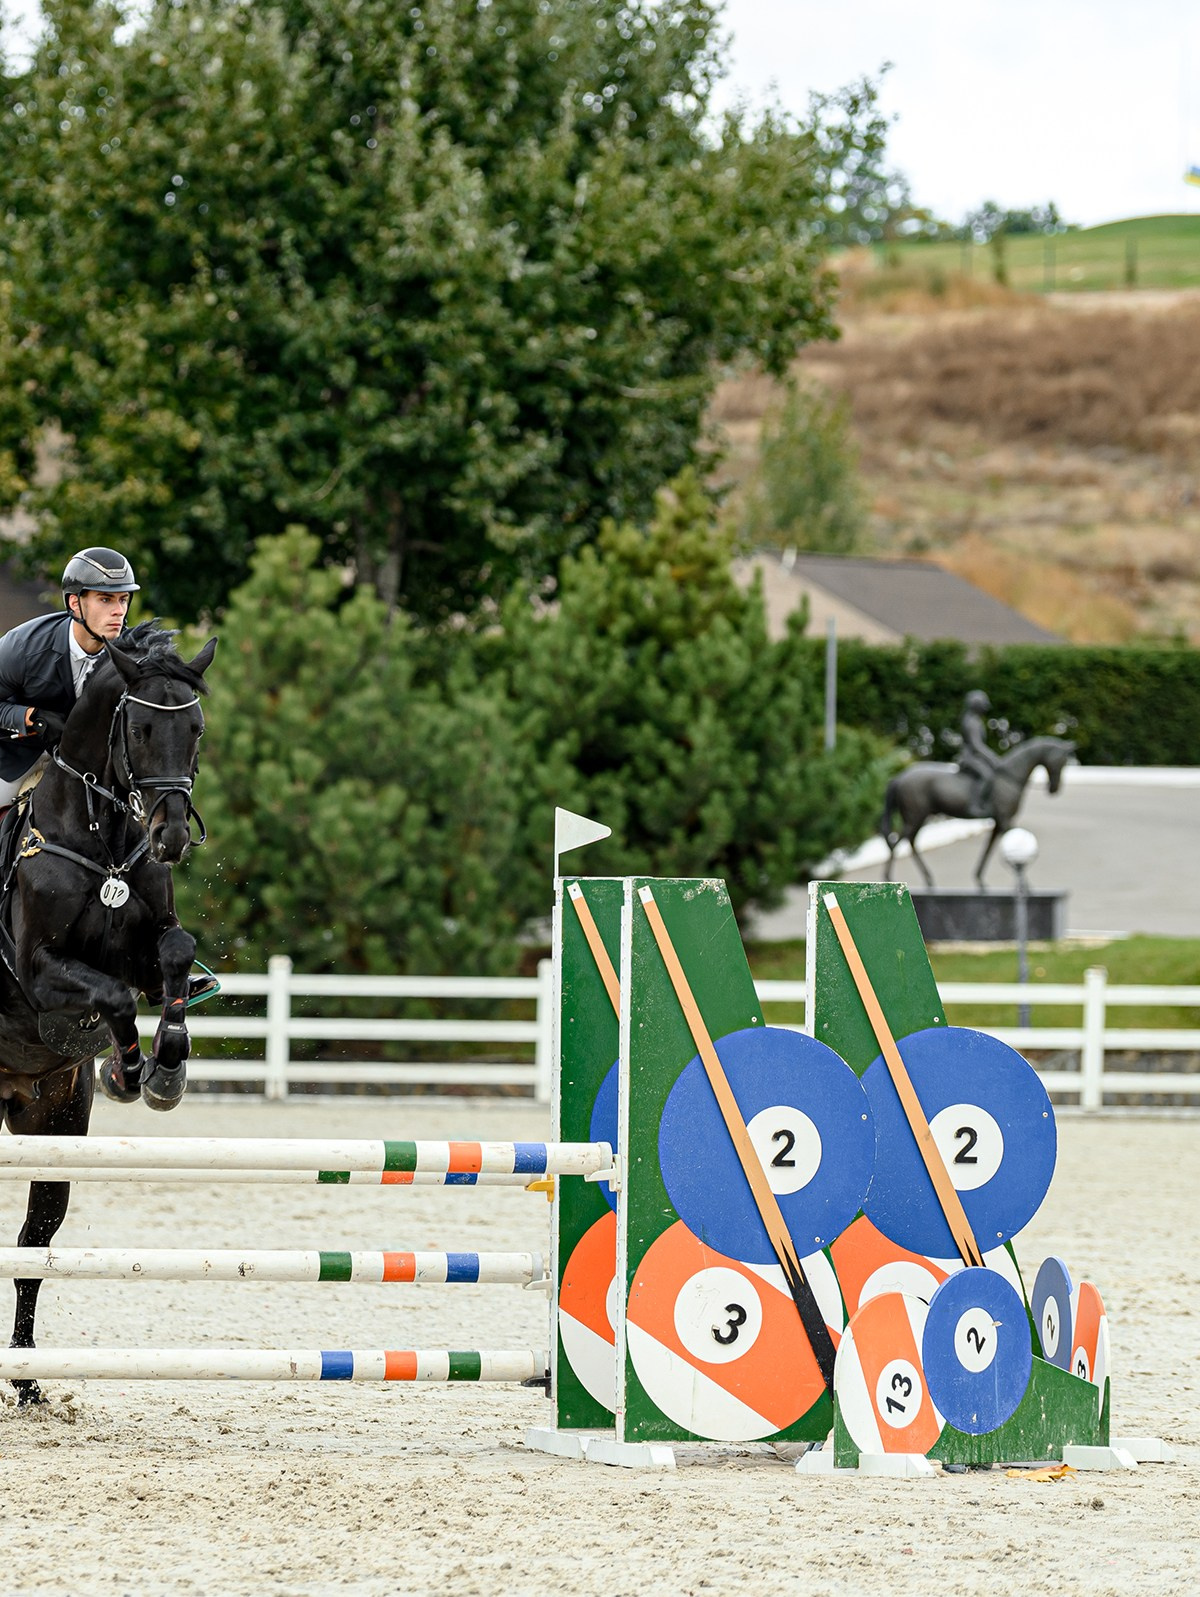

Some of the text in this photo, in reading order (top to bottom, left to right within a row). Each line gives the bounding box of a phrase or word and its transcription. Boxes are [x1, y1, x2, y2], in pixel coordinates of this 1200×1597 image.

[771, 1129, 796, 1168] 2
[953, 1126, 978, 1164] 2
[966, 1326, 986, 1354] 2
[1046, 1313, 1056, 1341] 2
[1077, 1359, 1087, 1380] 3
[885, 1372, 913, 1414] 13
